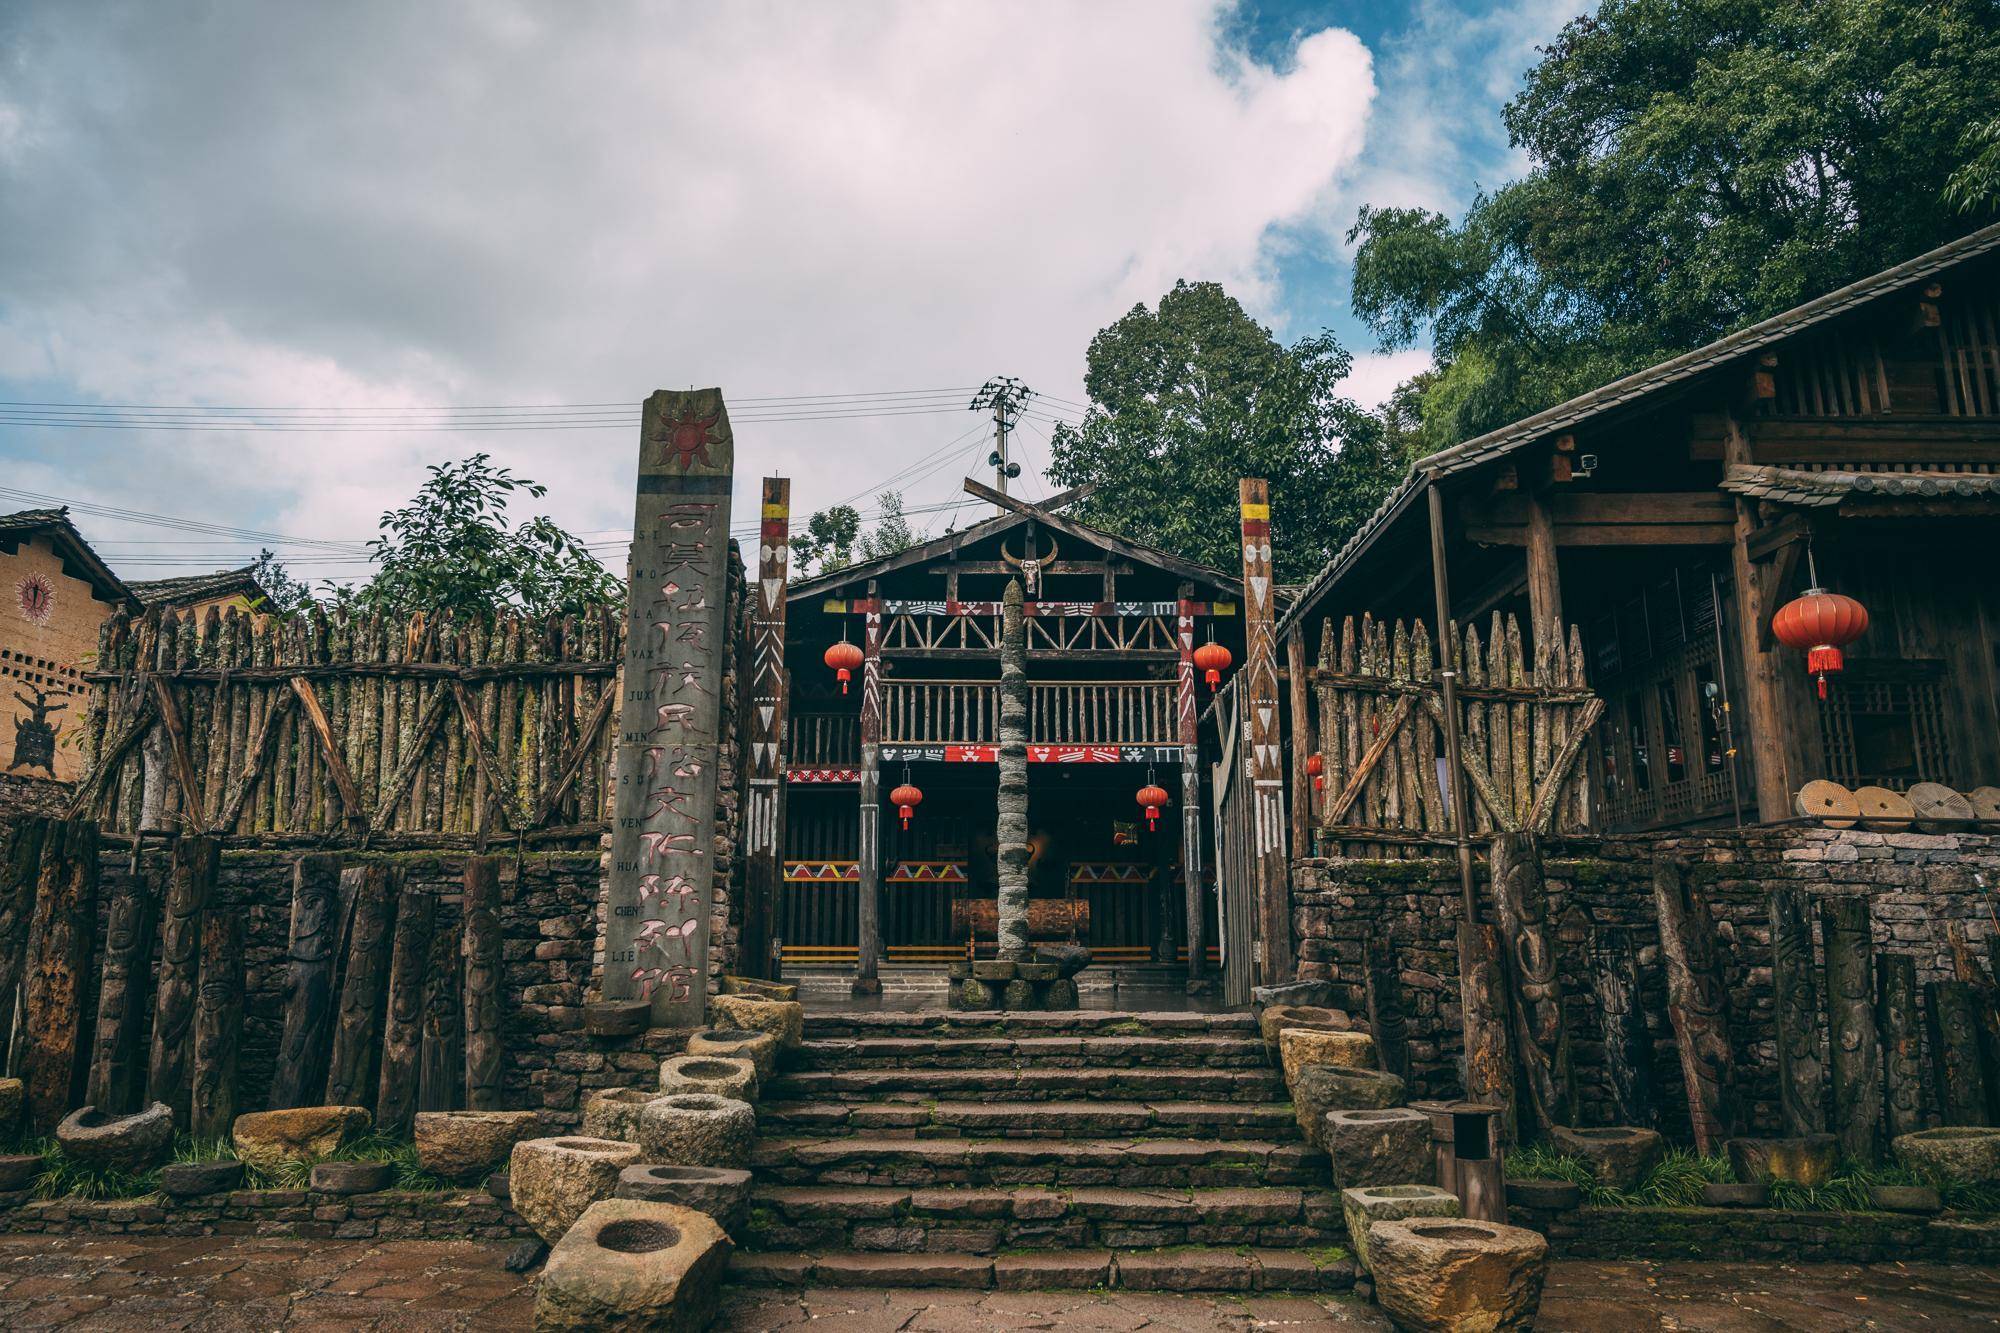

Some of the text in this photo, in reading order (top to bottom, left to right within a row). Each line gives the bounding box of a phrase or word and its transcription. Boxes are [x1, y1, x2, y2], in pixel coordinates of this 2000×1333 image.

[625, 732, 648, 742] MIN
[620, 818, 642, 828] VEN
[617, 862, 639, 872] HUA
[612, 950, 635, 962] LIE
